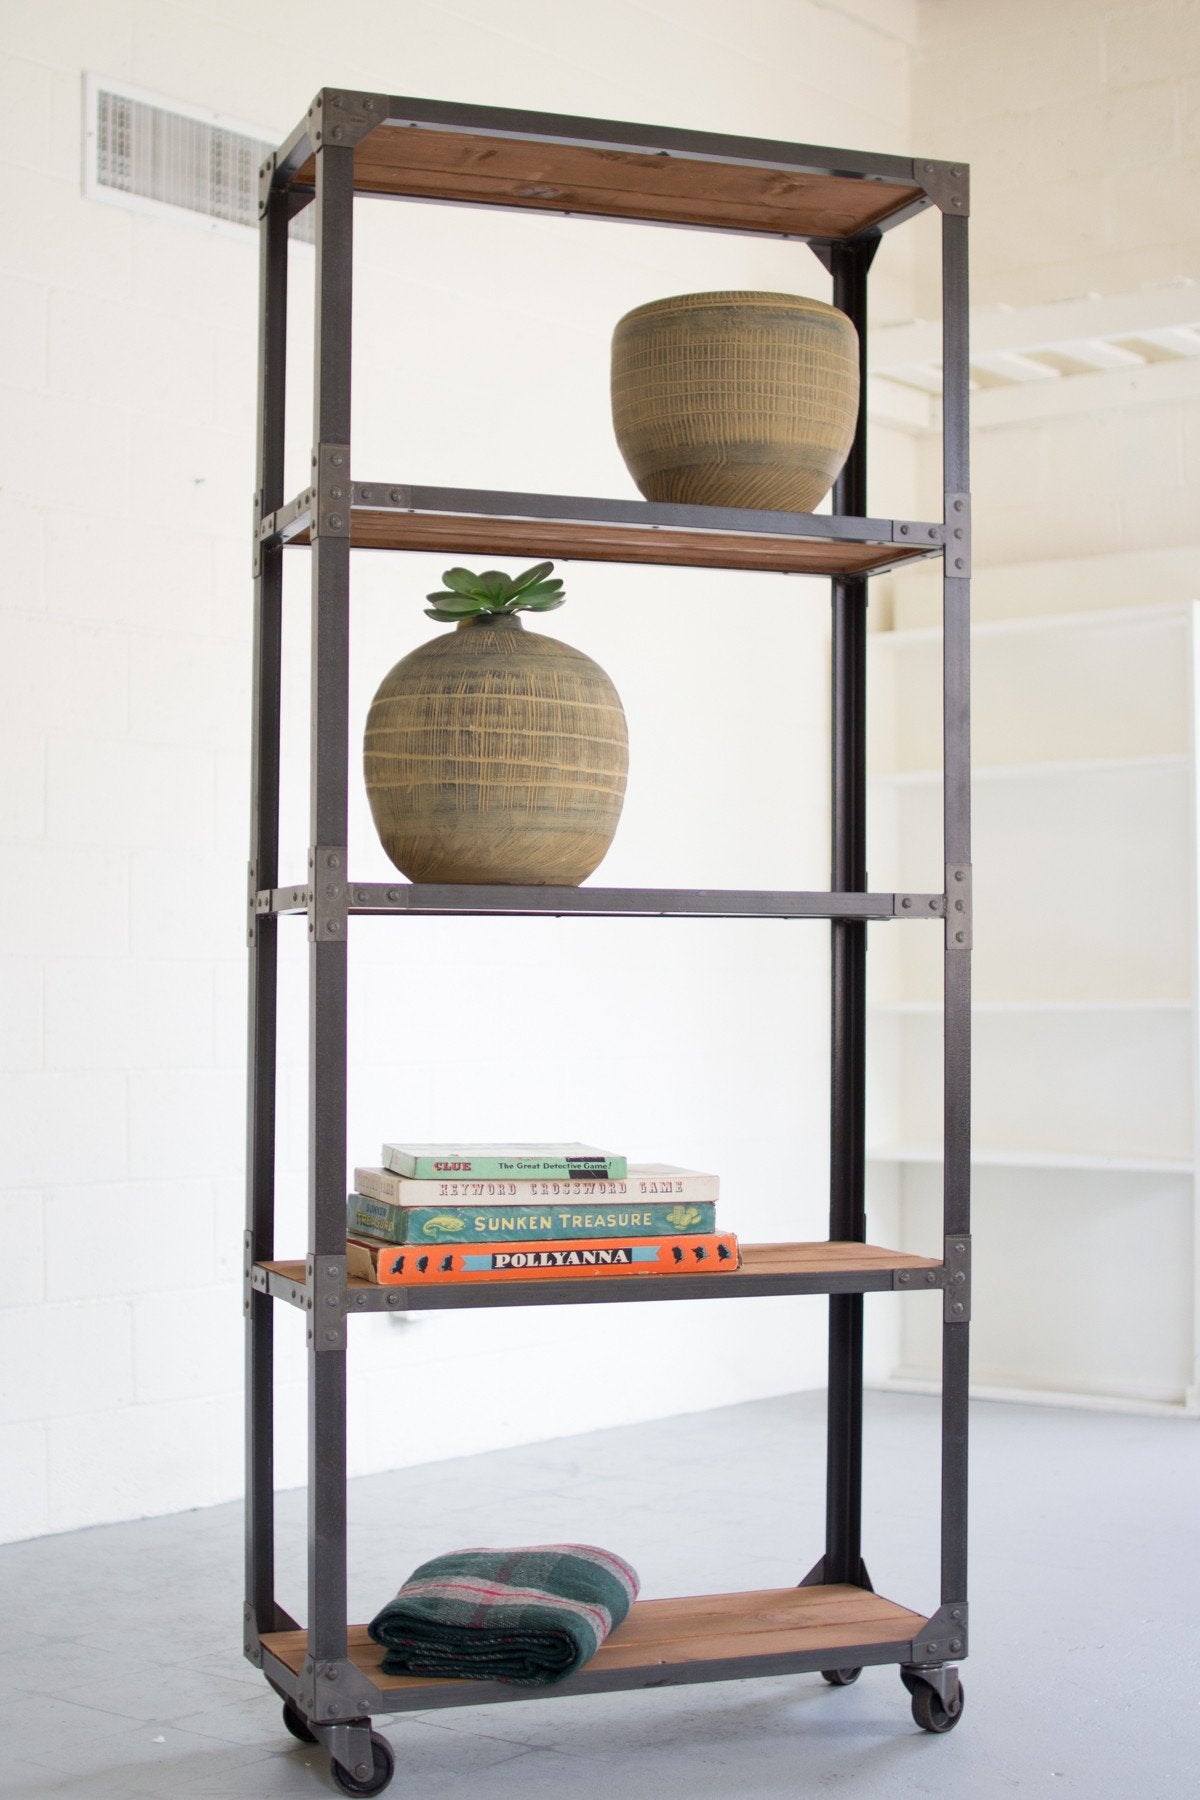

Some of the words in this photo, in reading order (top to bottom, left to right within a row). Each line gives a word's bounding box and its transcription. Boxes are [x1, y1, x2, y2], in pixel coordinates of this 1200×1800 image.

[433, 1161, 472, 1172] CLUE
[498, 1162, 515, 1170] The
[516, 1162, 540, 1170] Great
[543, 1162, 582, 1170] Detective
[583, 1161, 612, 1170] Game!
[439, 1183, 517, 1196] KEYWORD
[530, 1182, 628, 1196] CROSSWORD
[639, 1181, 684, 1194] GAME
[474, 1216, 552, 1231] SUNKEN
[558, 1213, 653, 1229] TREASURE
[494, 1249, 630, 1268] POLLYANNA
